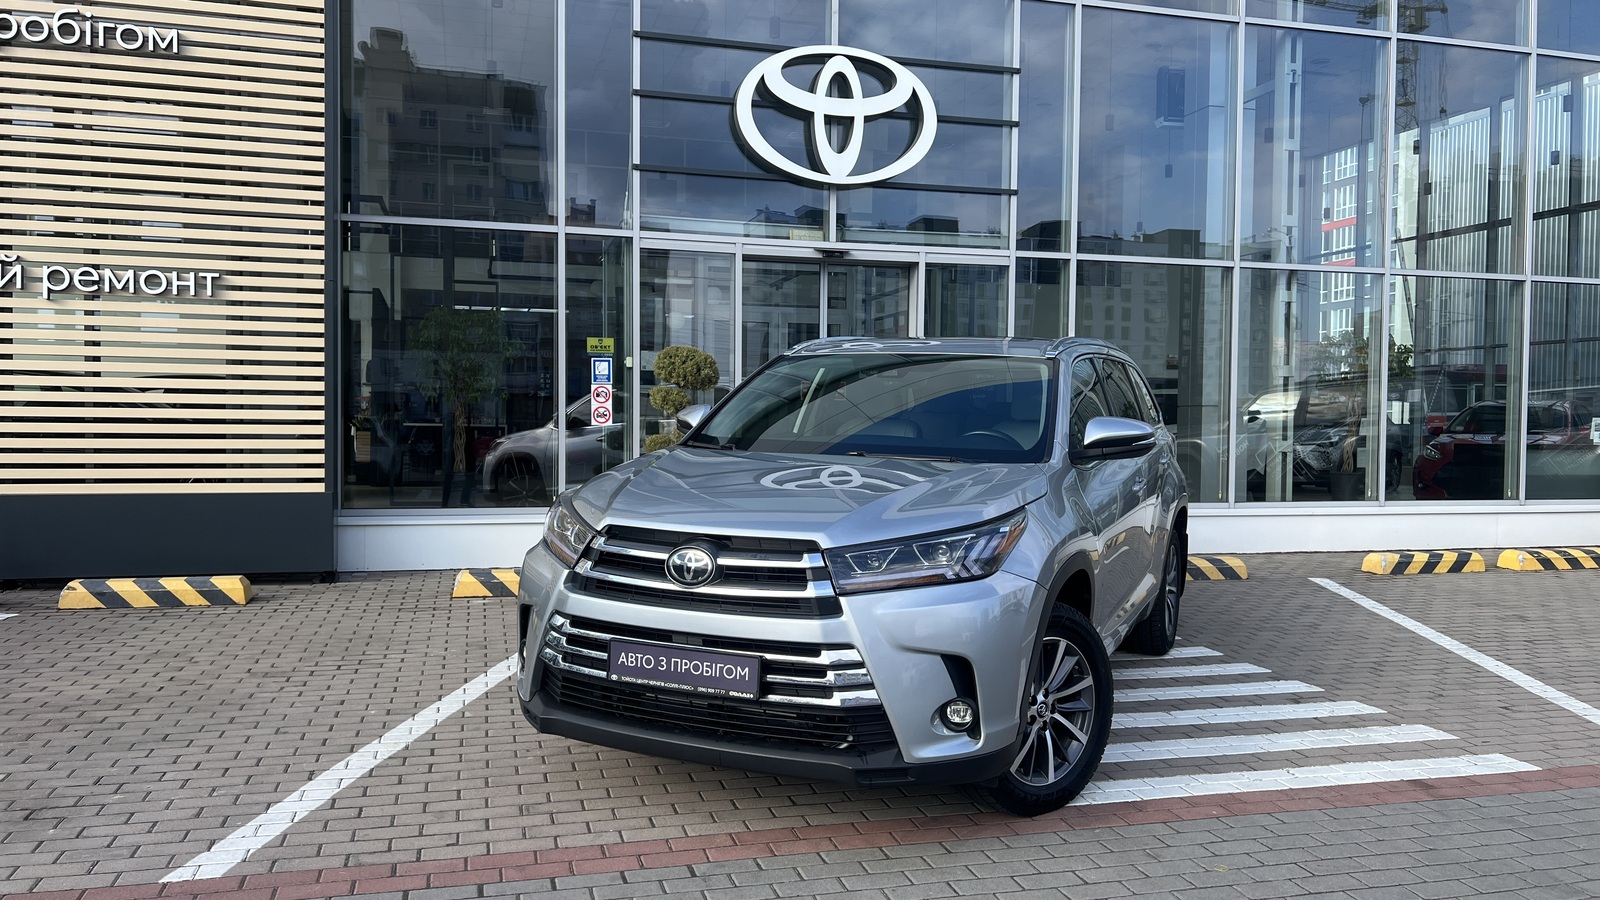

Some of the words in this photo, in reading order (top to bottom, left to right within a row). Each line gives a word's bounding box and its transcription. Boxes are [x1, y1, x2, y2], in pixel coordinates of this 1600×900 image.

[42, 264, 220, 300] ремонт
[618, 651, 655, 669] АВТО
[658, 656, 667, 671] З
[671, 658, 749, 681] ПРОБІГОМ
